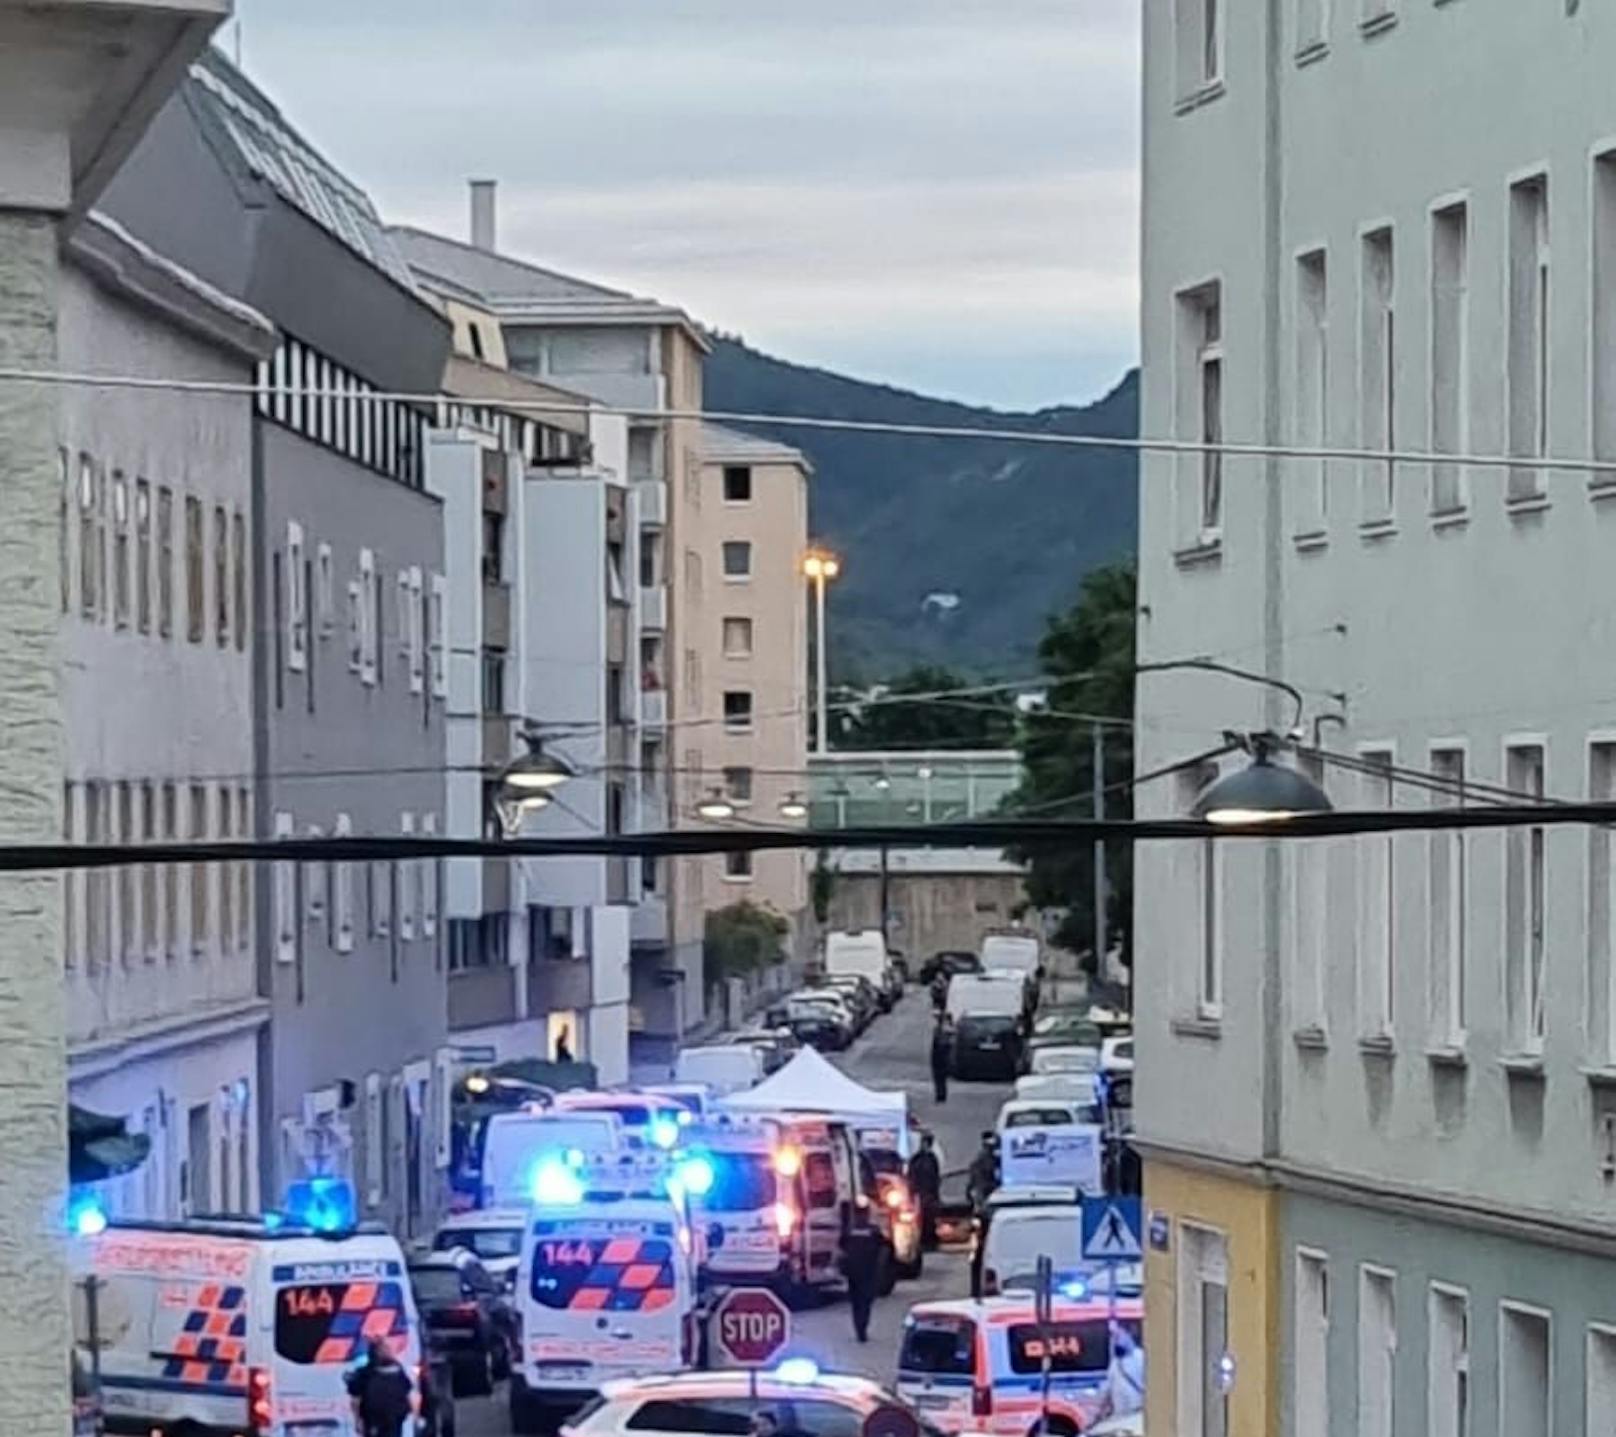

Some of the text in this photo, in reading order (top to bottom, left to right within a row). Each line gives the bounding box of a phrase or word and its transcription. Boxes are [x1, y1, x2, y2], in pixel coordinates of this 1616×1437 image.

[542, 1240, 594, 1266] 144
[285, 1287, 333, 1316] 144
[723, 1312, 781, 1342] STOP
